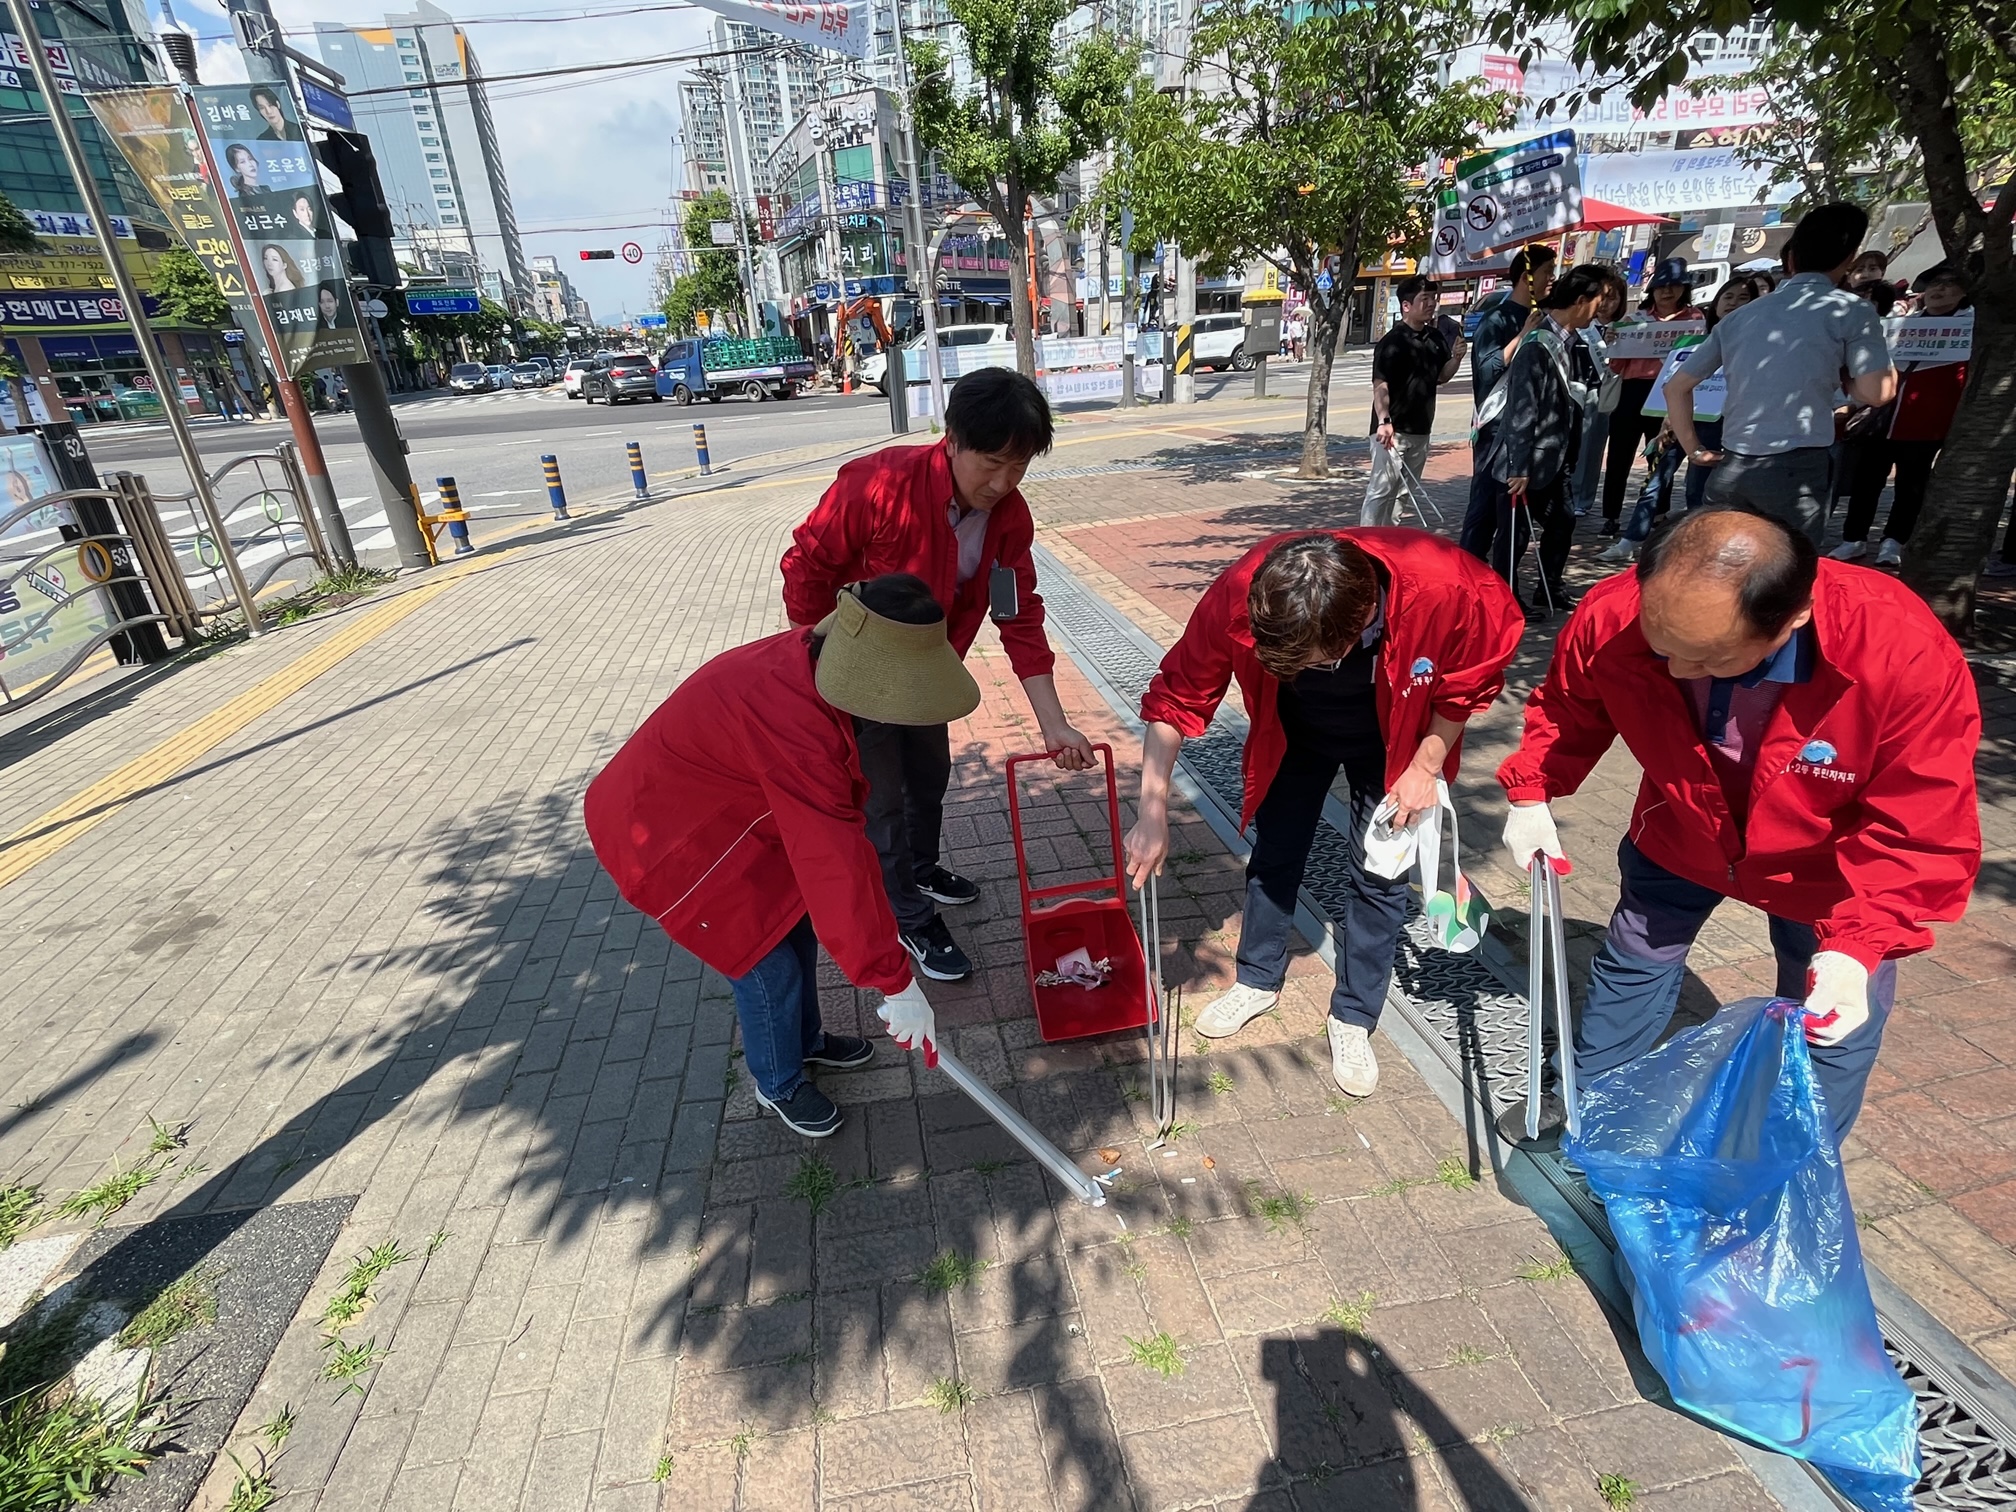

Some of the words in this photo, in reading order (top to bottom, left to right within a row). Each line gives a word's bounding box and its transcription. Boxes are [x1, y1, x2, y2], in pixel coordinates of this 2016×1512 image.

[206, 105, 251, 122] 김바울
[266, 157, 307, 173] 조윤경
[244, 214, 288, 231] 심근수
[626, 246, 639, 259] 40
[841, 242, 877, 267] 치과
[300, 255, 336, 274] 김경희
[276, 306, 318, 325] 김재민
[1899, 329, 1938, 338] 음주행위
[1897, 340, 1913, 349] 우리
[1916, 340, 1946, 349] 자녀를
[1949, 340, 1970, 349] 보호
[66, 438, 85, 458] 52
[113, 548, 129, 568] 53
